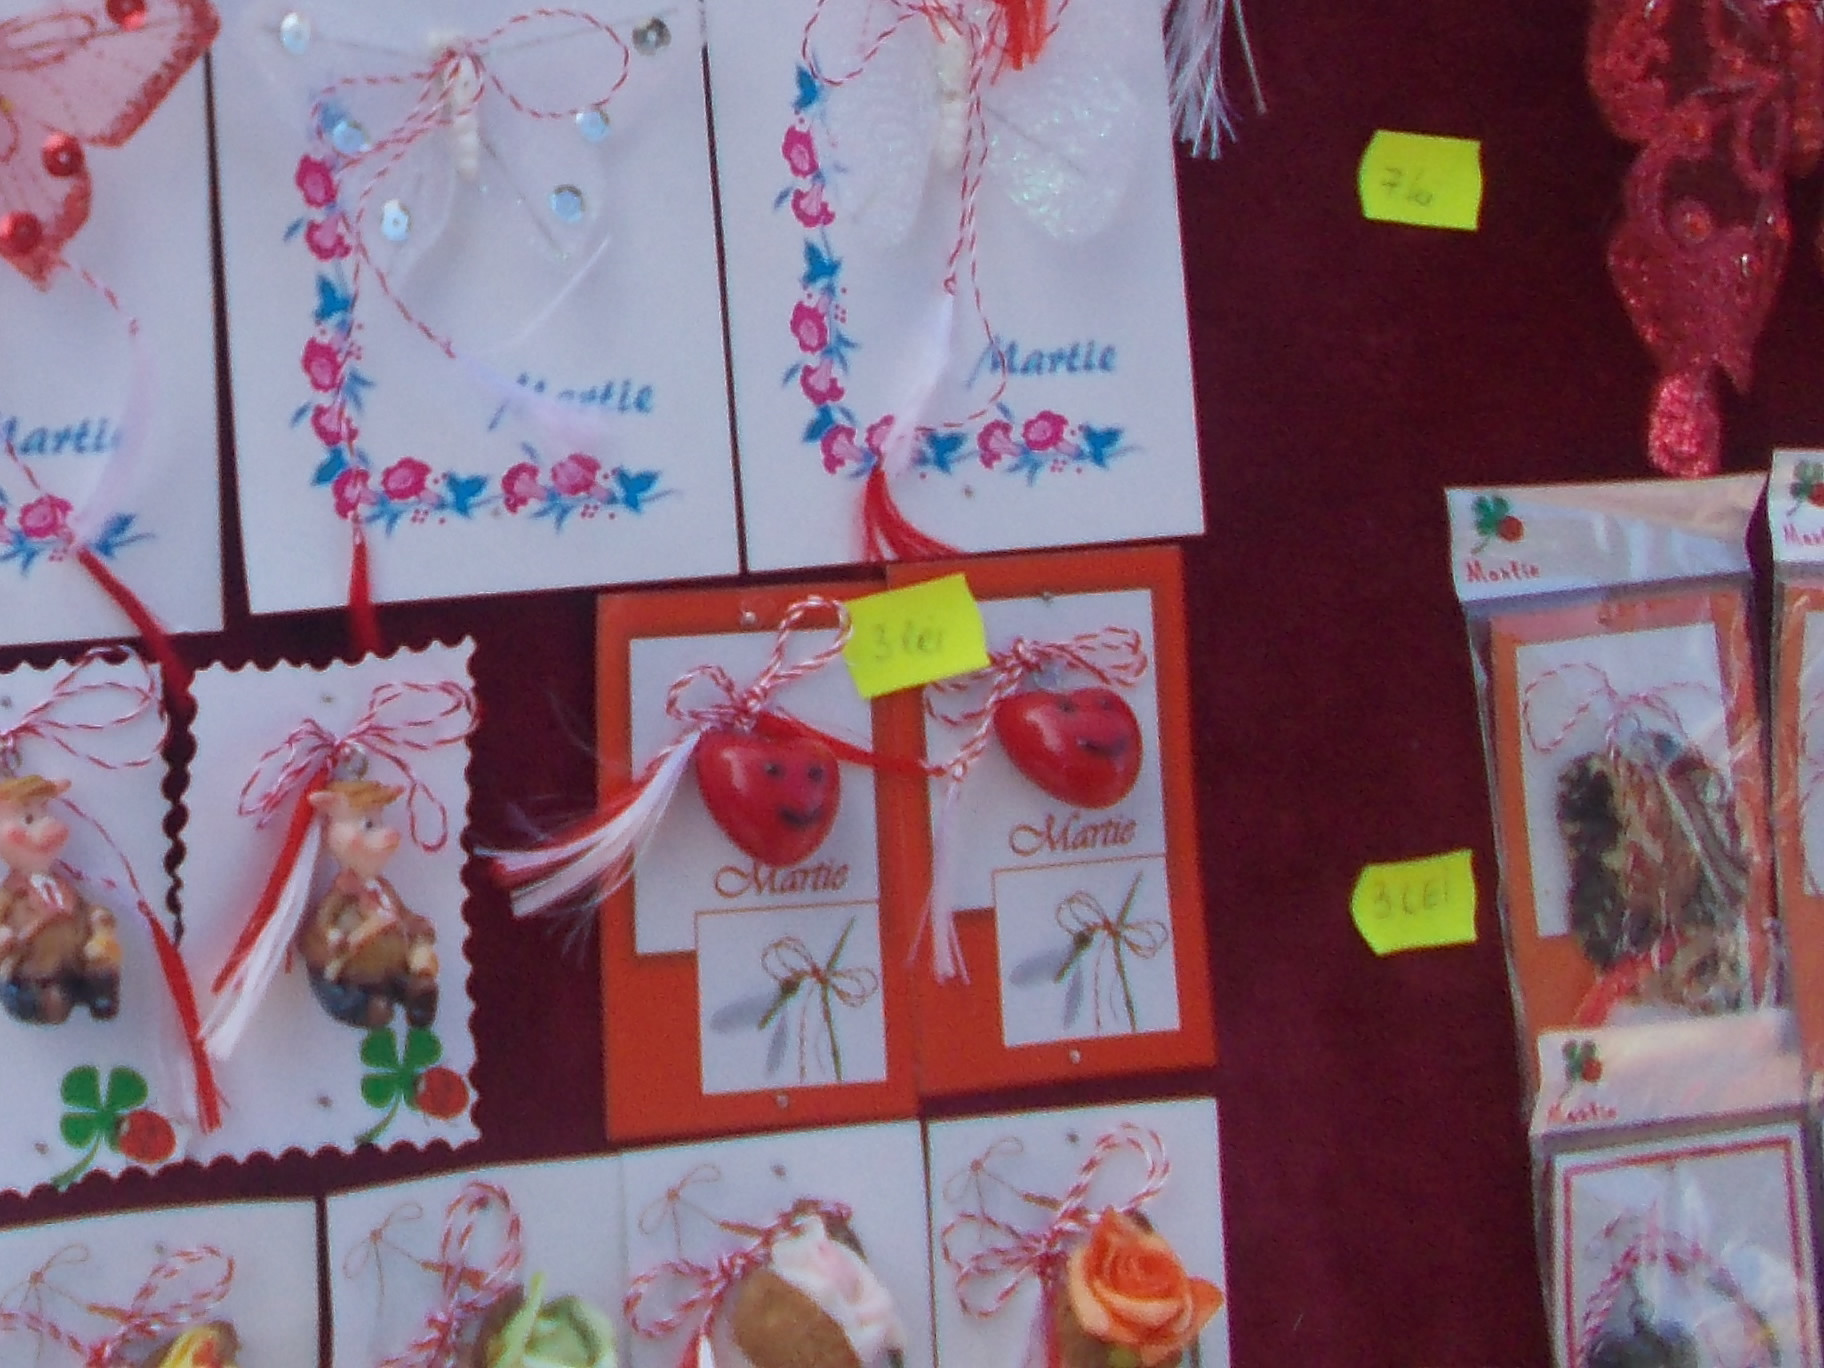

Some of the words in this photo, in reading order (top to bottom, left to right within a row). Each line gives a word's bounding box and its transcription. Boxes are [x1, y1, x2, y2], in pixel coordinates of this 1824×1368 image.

[966, 333, 1117, 388] Martie
[1008, 811, 1138, 857] Martie
[714, 858, 850, 900] Martie
